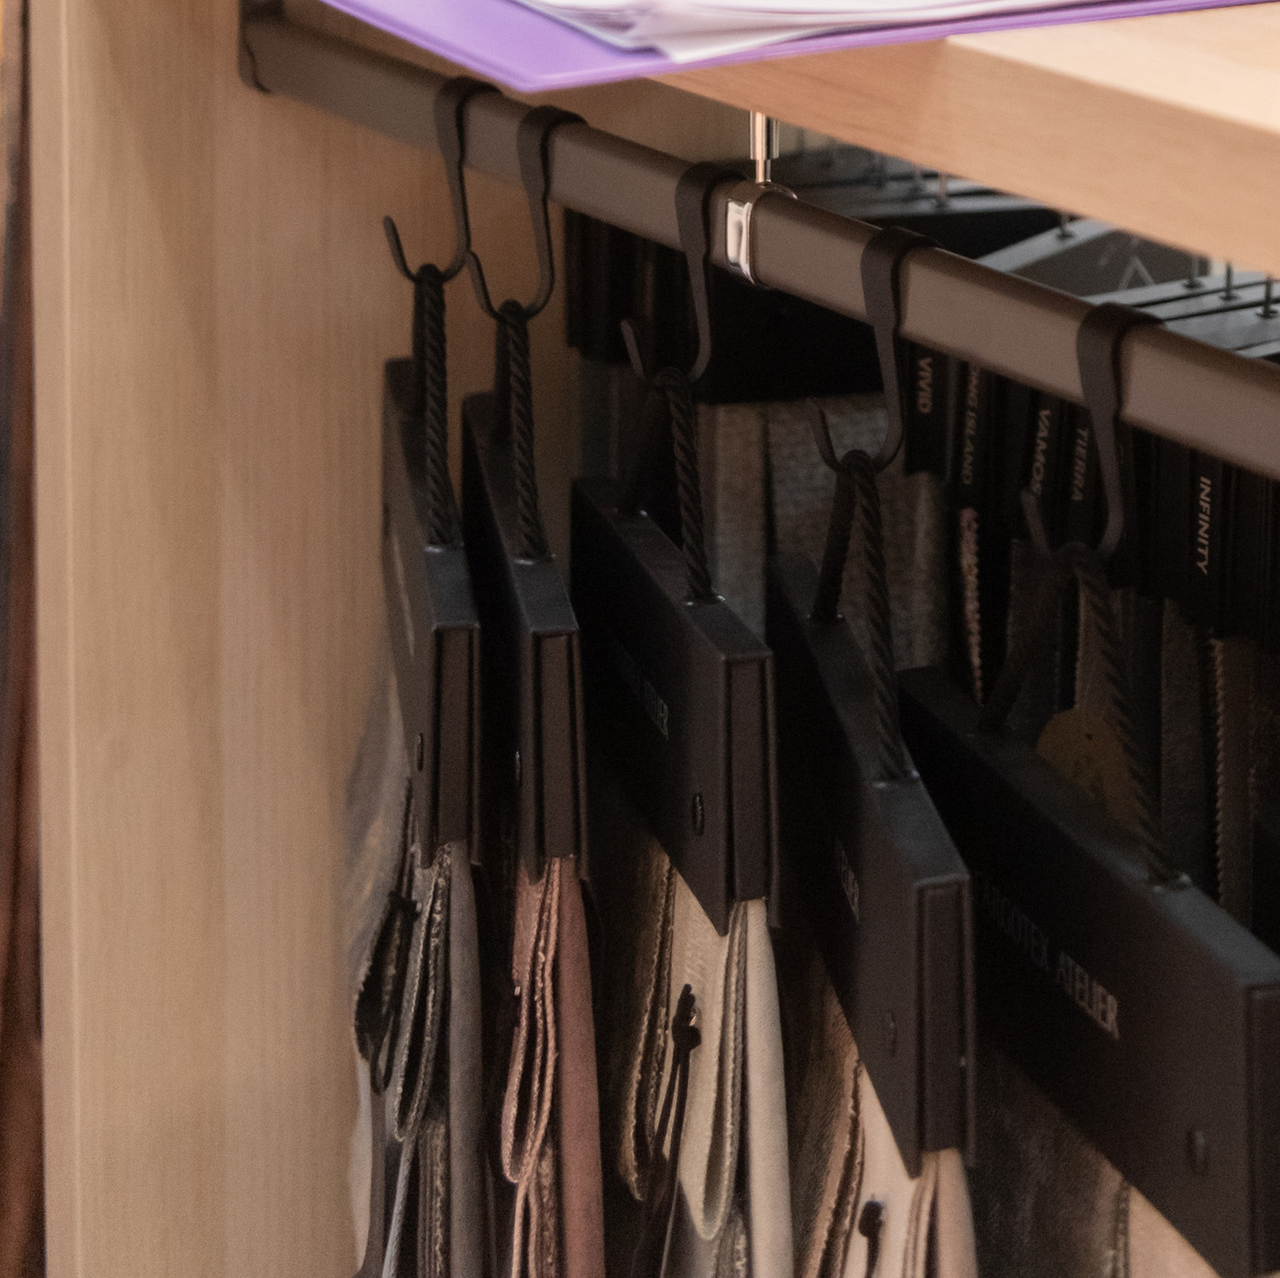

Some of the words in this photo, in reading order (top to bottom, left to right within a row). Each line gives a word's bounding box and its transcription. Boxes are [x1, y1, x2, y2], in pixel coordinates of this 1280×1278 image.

[916, 356, 933, 415] VIVID
[966, 363, 981, 408] ONG
[1032, 408, 1052, 494] VAMOS
[1070, 426, 1089, 502] TIERRA
[1195, 476, 1212, 576] INFINITY
